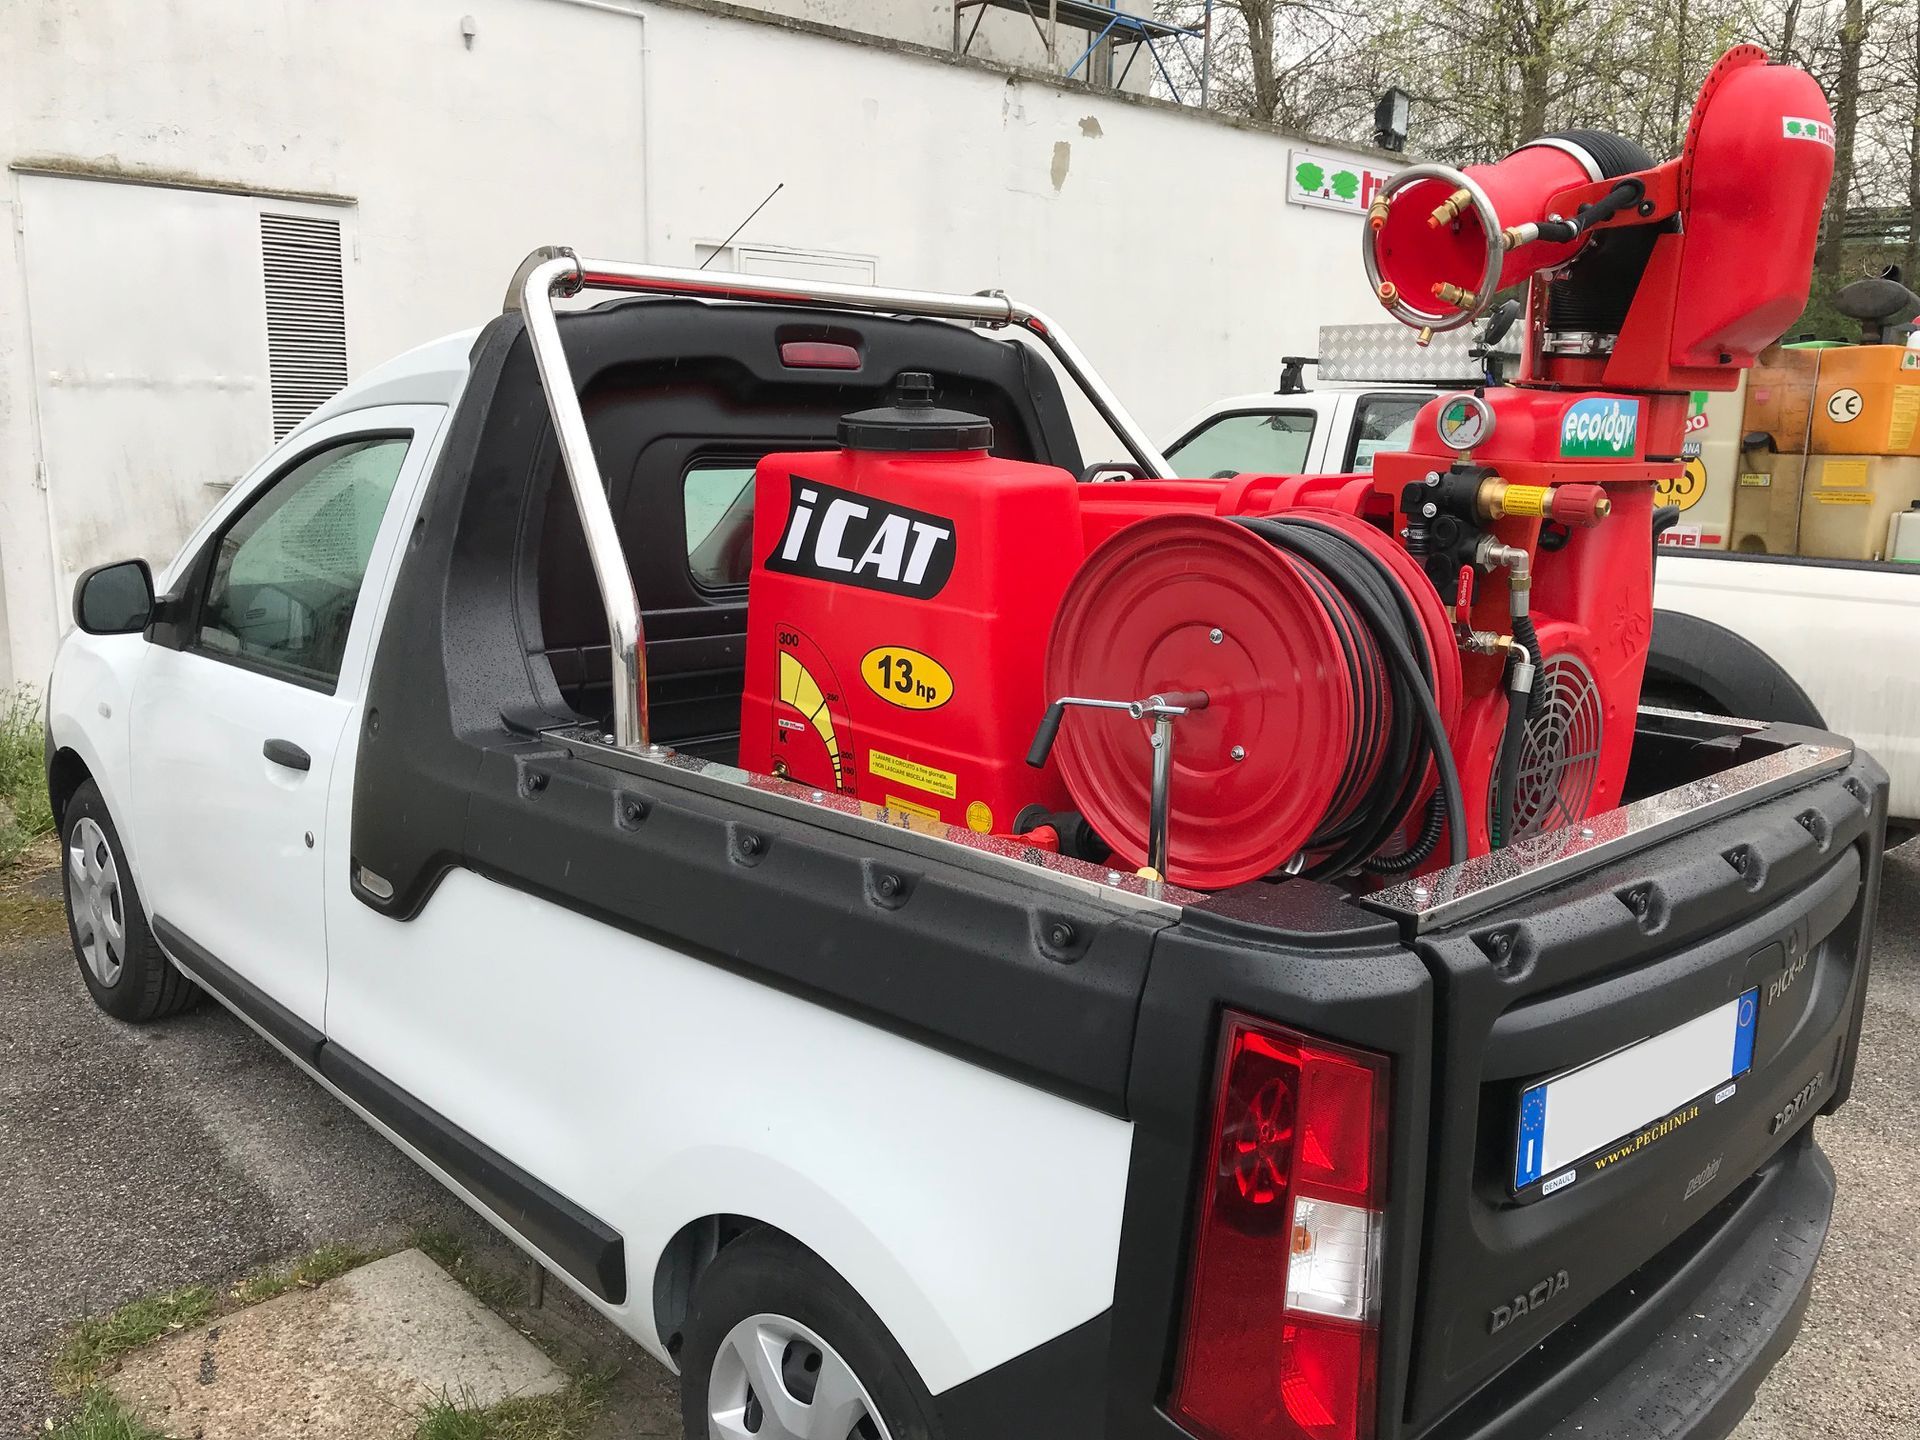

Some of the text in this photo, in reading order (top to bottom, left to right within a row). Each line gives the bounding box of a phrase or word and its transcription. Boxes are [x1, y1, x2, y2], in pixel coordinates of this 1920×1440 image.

[782, 488, 950, 585] iCAT
[779, 631, 799, 647] 300
[826, 693, 839, 702] 250
[779, 730, 787, 744] K
[841, 751, 853, 760] 200
[843, 766, 855, 776] 150
[844, 786, 856, 795] 100
[1595, 1106, 1699, 1170] www.PECHINI.it
[1544, 1171, 1575, 1192] RENAULT
[1490, 1269, 1569, 1335] DACIA
